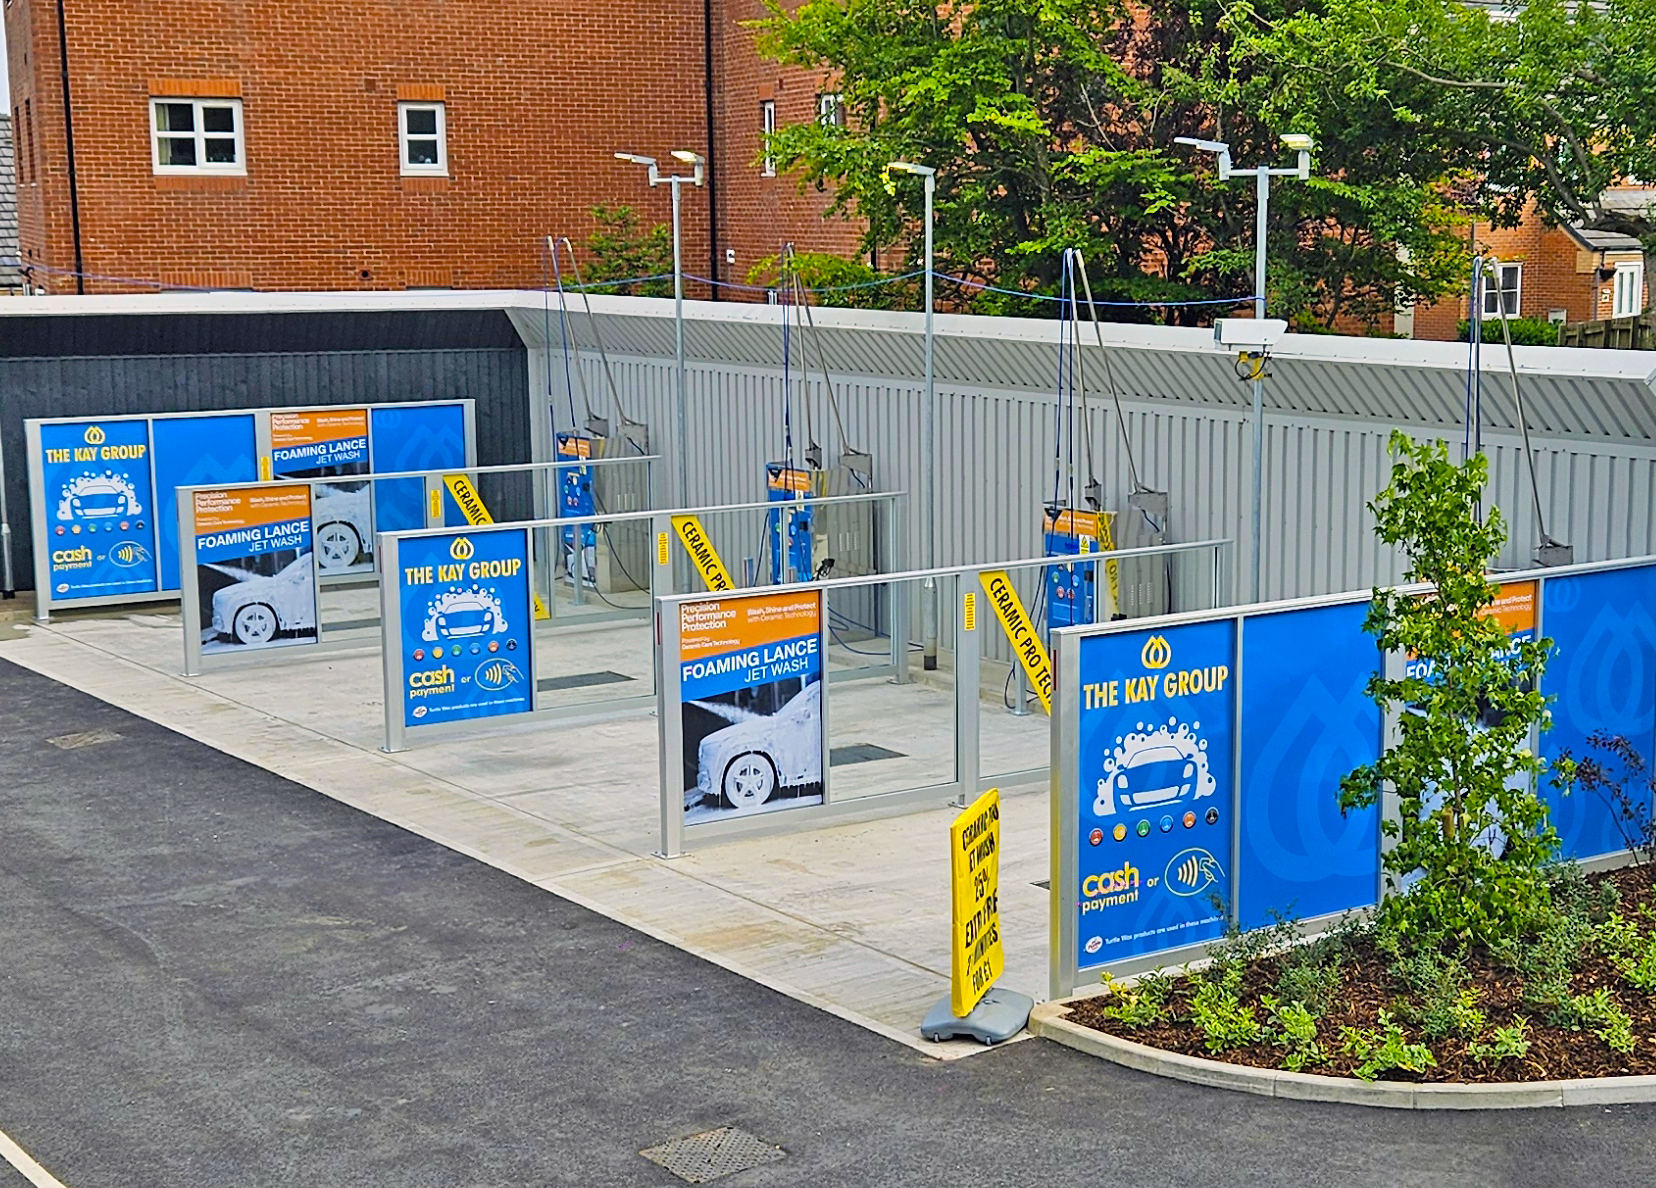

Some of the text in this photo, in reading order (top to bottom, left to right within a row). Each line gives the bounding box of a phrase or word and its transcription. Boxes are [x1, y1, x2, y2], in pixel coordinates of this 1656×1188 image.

[45, 445, 146, 463] THE KAY GROUP
[274, 439, 366, 461] FOAMING LANCE
[316, 450, 360, 464] JET WASH
[454, 480, 487, 525] CERAMIC
[198, 528, 261, 549] FOAMING
[264, 520, 309, 538] LANCE
[249, 534, 302, 552] JET WASH
[52, 545, 92, 563] cash
[682, 522, 717, 575] CERAMIC
[53, 561, 92, 572] payment
[405, 558, 521, 585] THE KAY GROUP
[682, 602, 720, 613] Precision
[682, 610, 736, 622] Performance
[682, 620, 726, 632] Protection
[990, 578, 1051, 704] CERAMIC PRO TEC
[683, 638, 817, 682] FOAMING LANCE
[744, 657, 808, 683] JET WASH
[409, 664, 471, 688] cash or
[1083, 665, 1228, 710] THE KAY GROUP
[409, 684, 455, 699] payment
[977, 831, 995, 866] WASH
[1082, 861, 1160, 897] cash or
[1082, 889, 1139, 915] payment
[1105, 936, 1120, 945] Turtle
[1133, 929, 1155, 940] products
[1167, 923, 1179, 932] used
[1186, 920, 1199, 928] these
